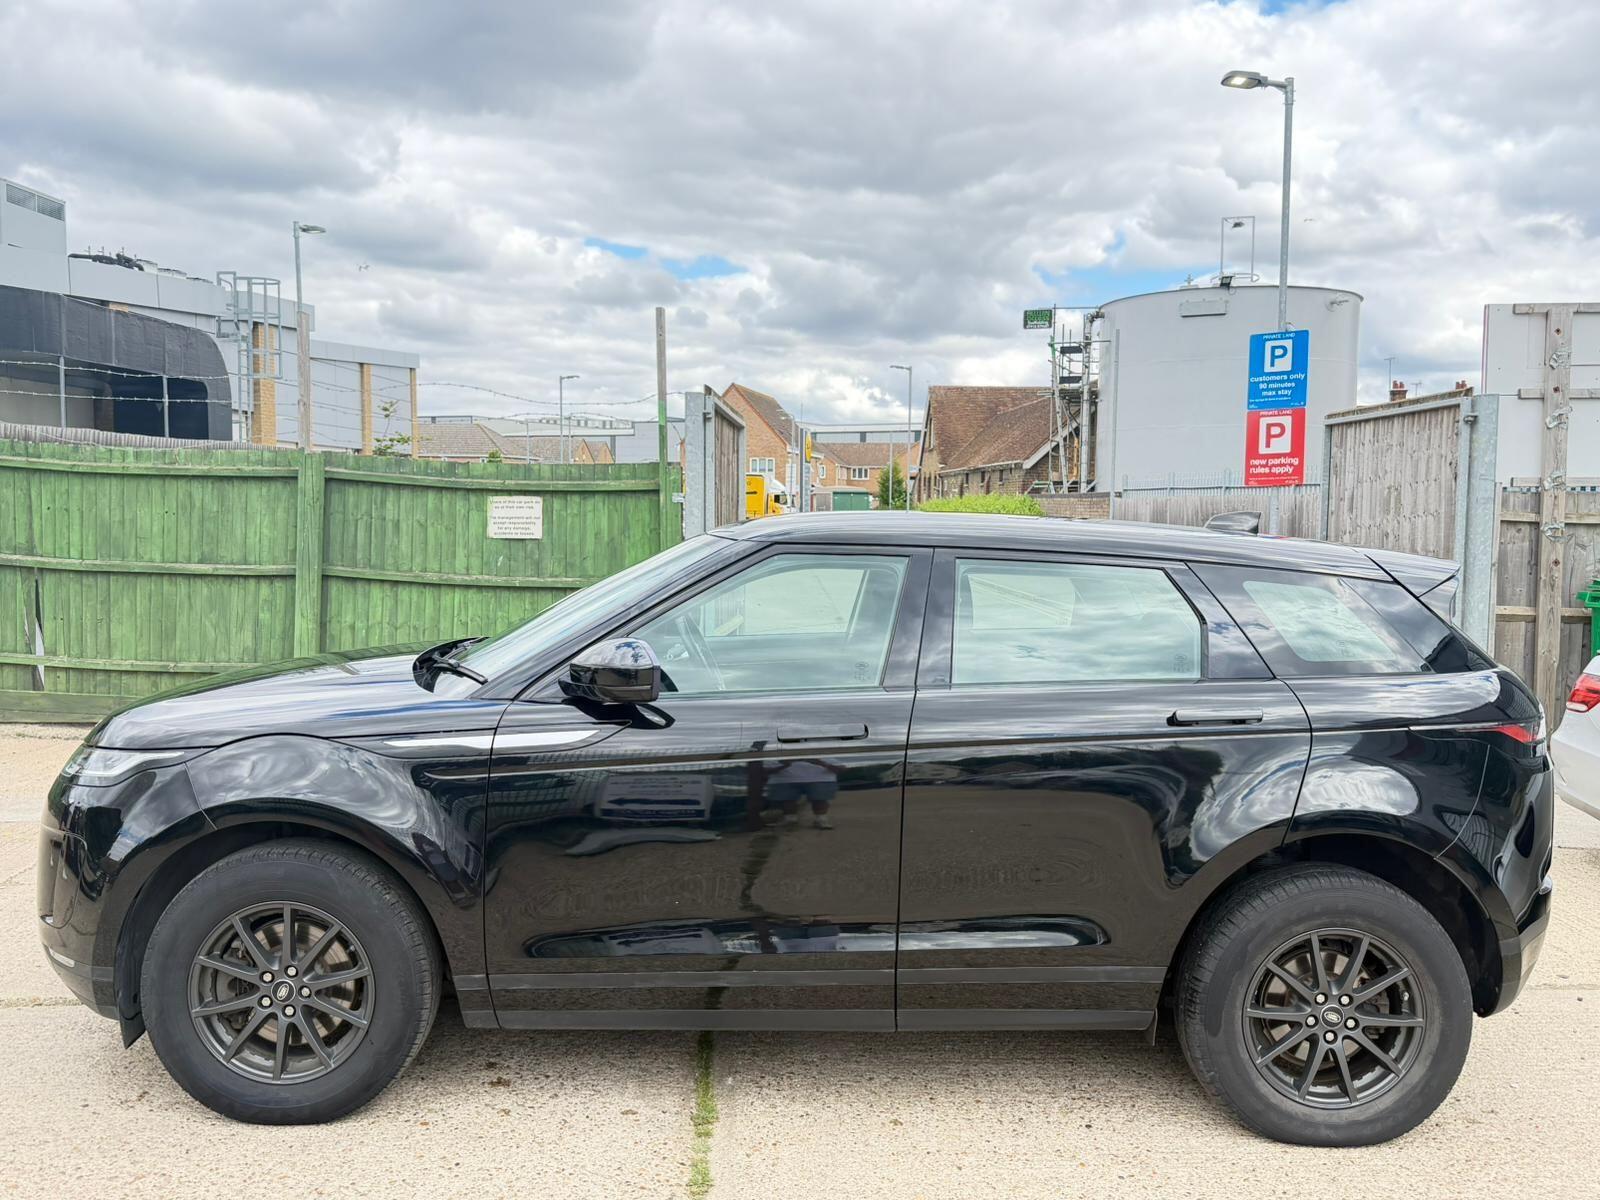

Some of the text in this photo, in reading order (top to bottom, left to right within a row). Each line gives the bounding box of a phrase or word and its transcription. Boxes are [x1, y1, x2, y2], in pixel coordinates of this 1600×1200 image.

[1270, 345, 1288, 368] P
[1250, 372, 1305, 382] customers only
[1278, 389, 1292, 397] stay
[1265, 422, 1286, 448] P
[1268, 456, 1298, 466] parking
[1271, 465, 1294, 474] apply
